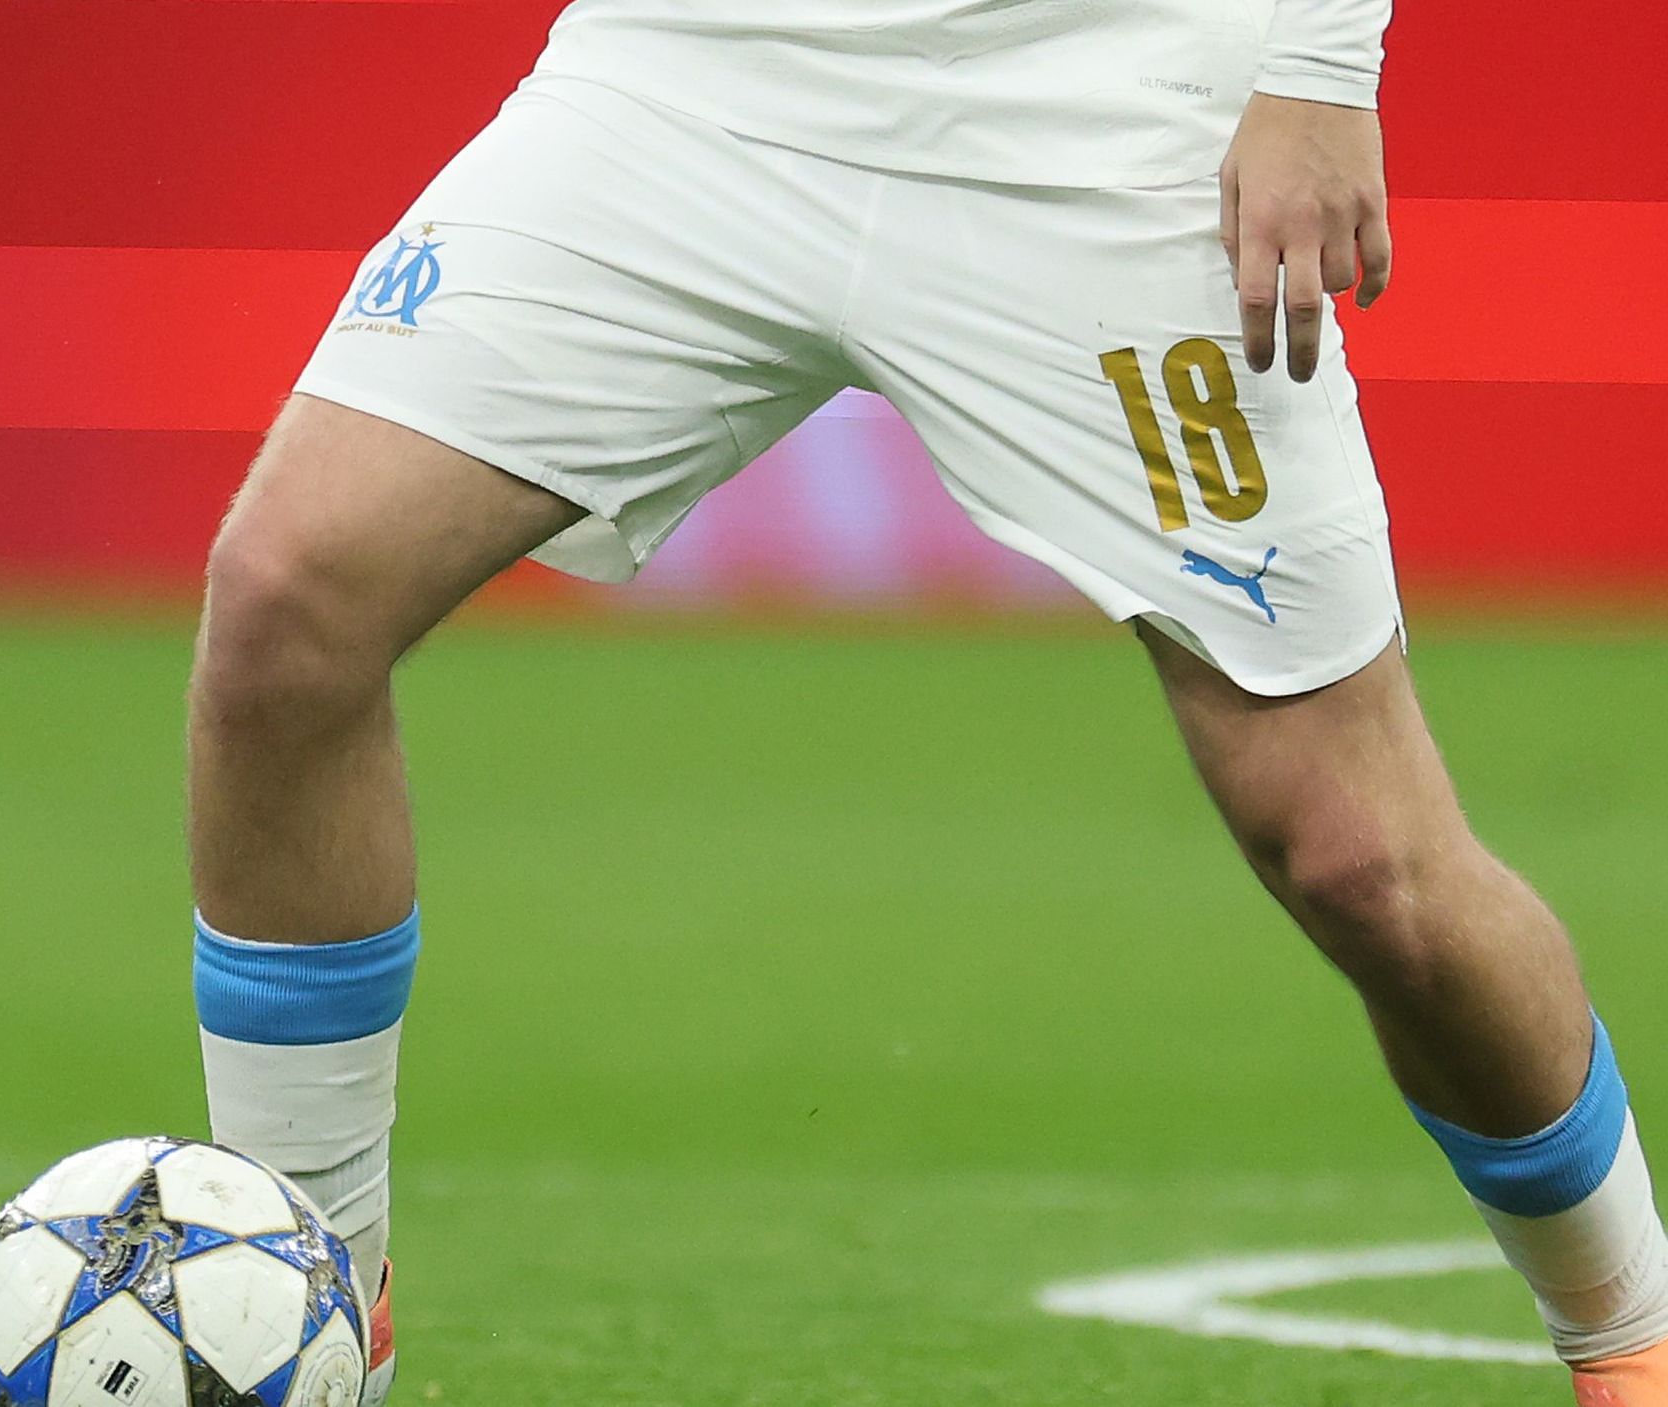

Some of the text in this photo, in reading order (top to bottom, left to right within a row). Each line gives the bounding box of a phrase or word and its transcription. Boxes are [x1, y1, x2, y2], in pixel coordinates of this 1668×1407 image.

[1139, 76, 1214, 98] ULTRAWEAVE
[365, 323, 383, 332] AU
[1098, 337, 1269, 534] 18
